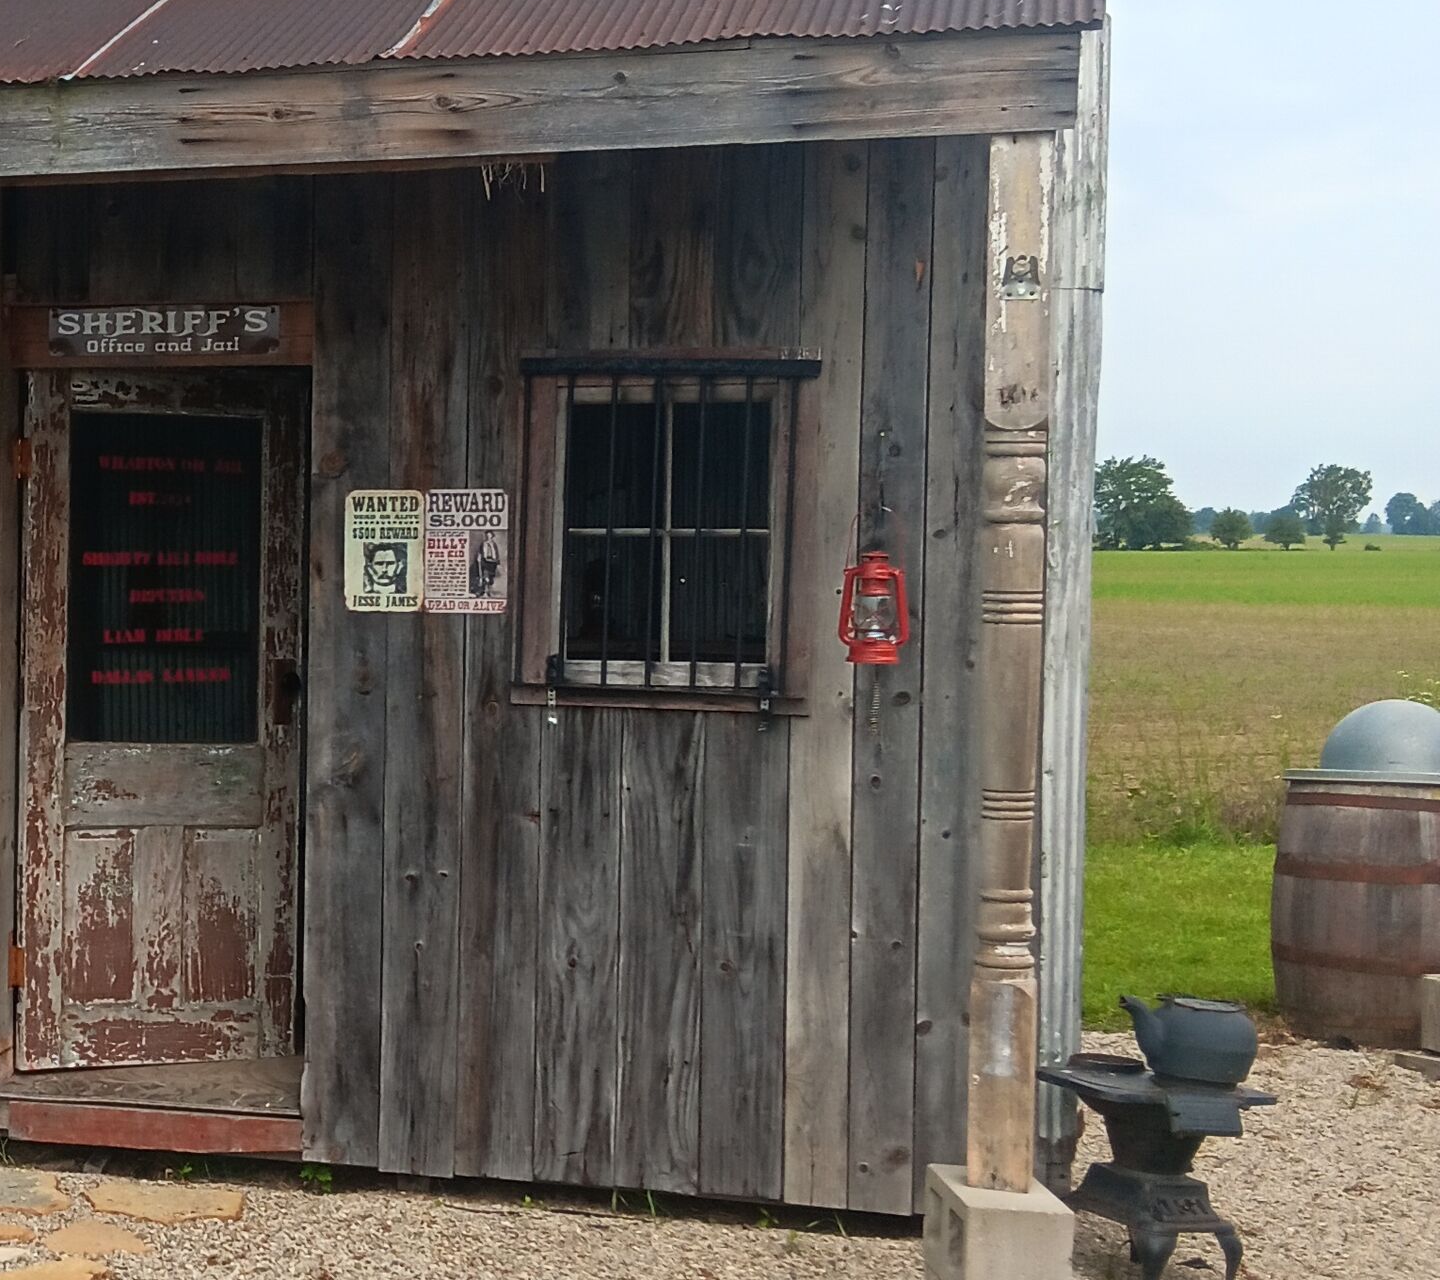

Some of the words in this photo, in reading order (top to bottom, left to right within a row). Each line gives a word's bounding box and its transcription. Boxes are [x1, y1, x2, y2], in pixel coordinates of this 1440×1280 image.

[57, 306, 269, 337] SHERIFF'S
[86, 338, 146, 353] Office
[154, 337, 192, 353] and
[200, 336, 240, 352] Jail
[352, 496, 420, 512] WANTED
[428, 493, 506, 513] REWARD
[352, 527, 376, 539] $500
[379, 527, 419, 539] REWARD
[427, 538, 468, 549] BILLY
[352, 596, 382, 608] JESSE
[386, 595, 418, 608] JAMES
[427, 600, 456, 611] DEAD
[458, 600, 470, 610] OR
[473, 600, 506, 611] ALIVE
